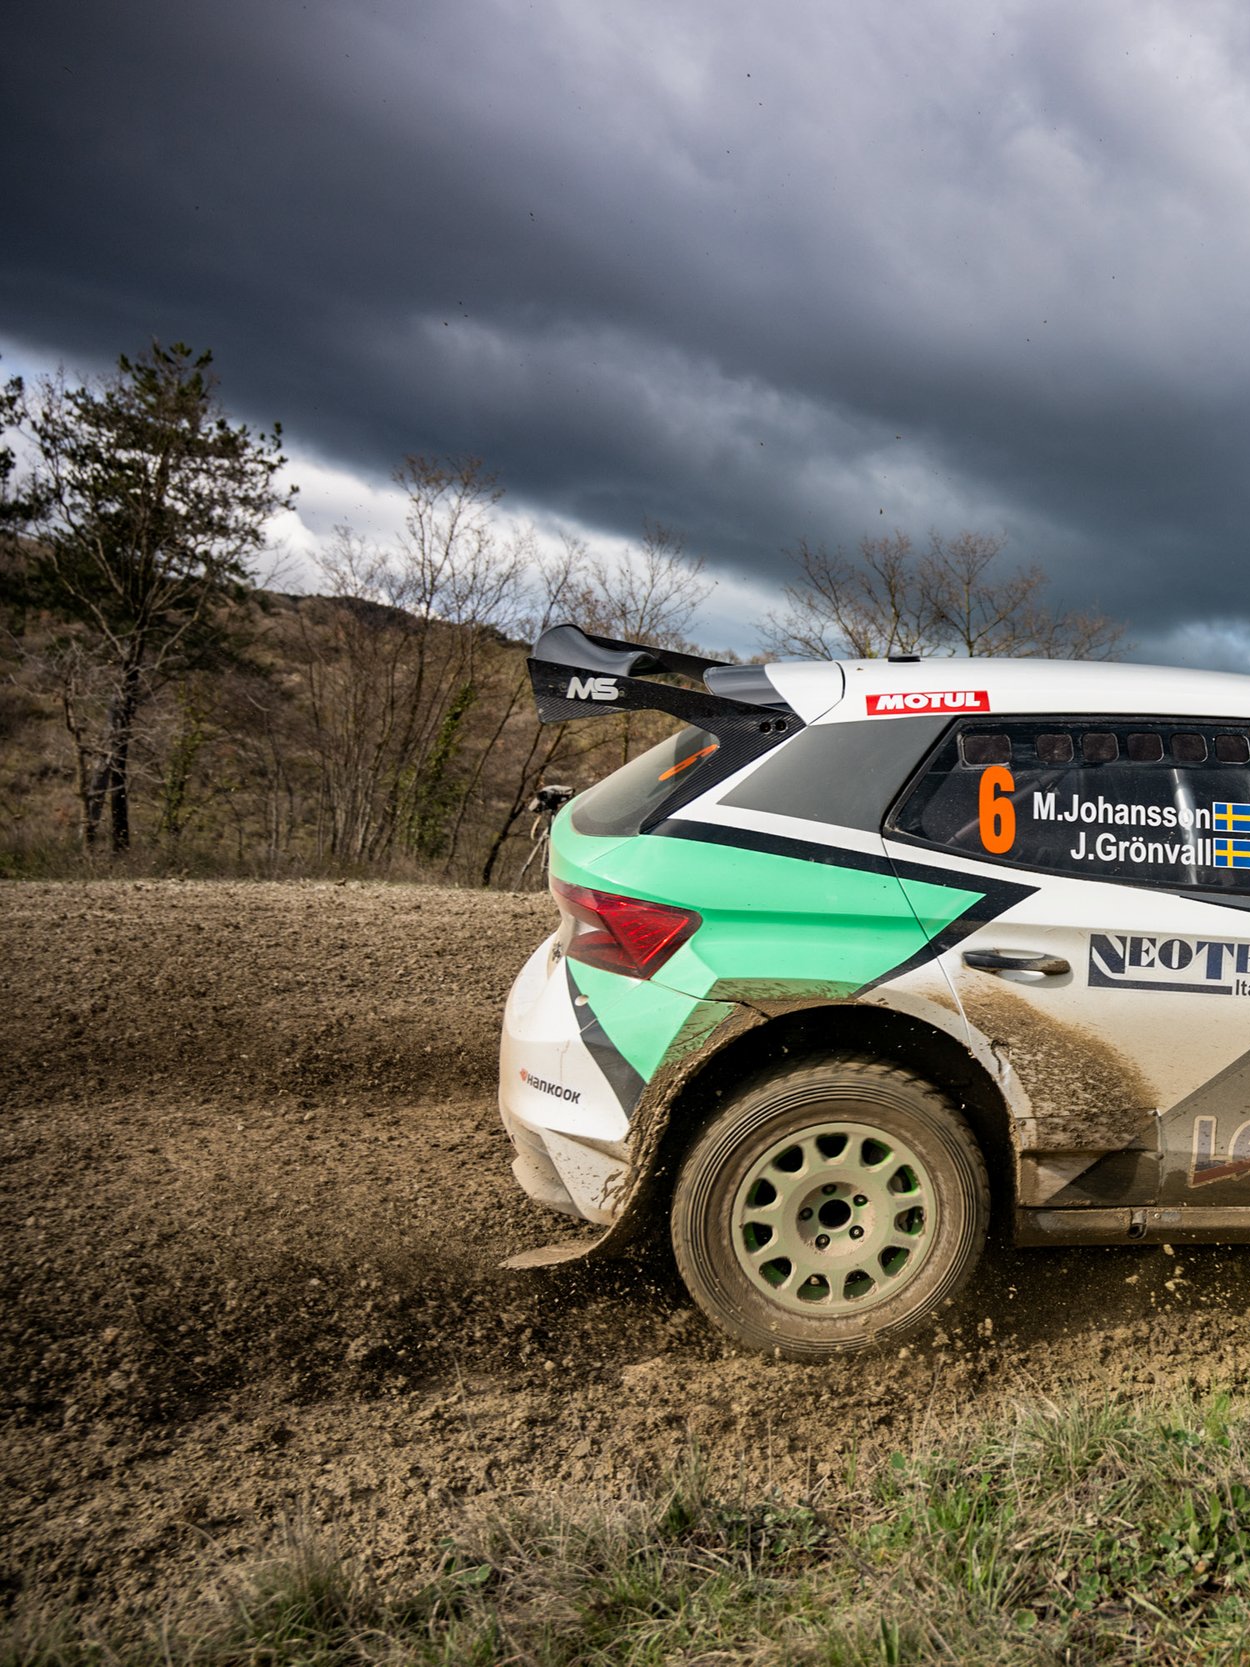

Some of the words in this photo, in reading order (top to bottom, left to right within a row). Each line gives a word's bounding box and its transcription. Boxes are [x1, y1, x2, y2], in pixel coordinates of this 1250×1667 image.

[566, 676, 619, 701] MS
[876, 692, 981, 710] MOTUL
[979, 765, 1016, 854] 6
[1033, 791, 1211, 830] M.Johansson
[1070, 832, 1211, 867] J.Grönvall
